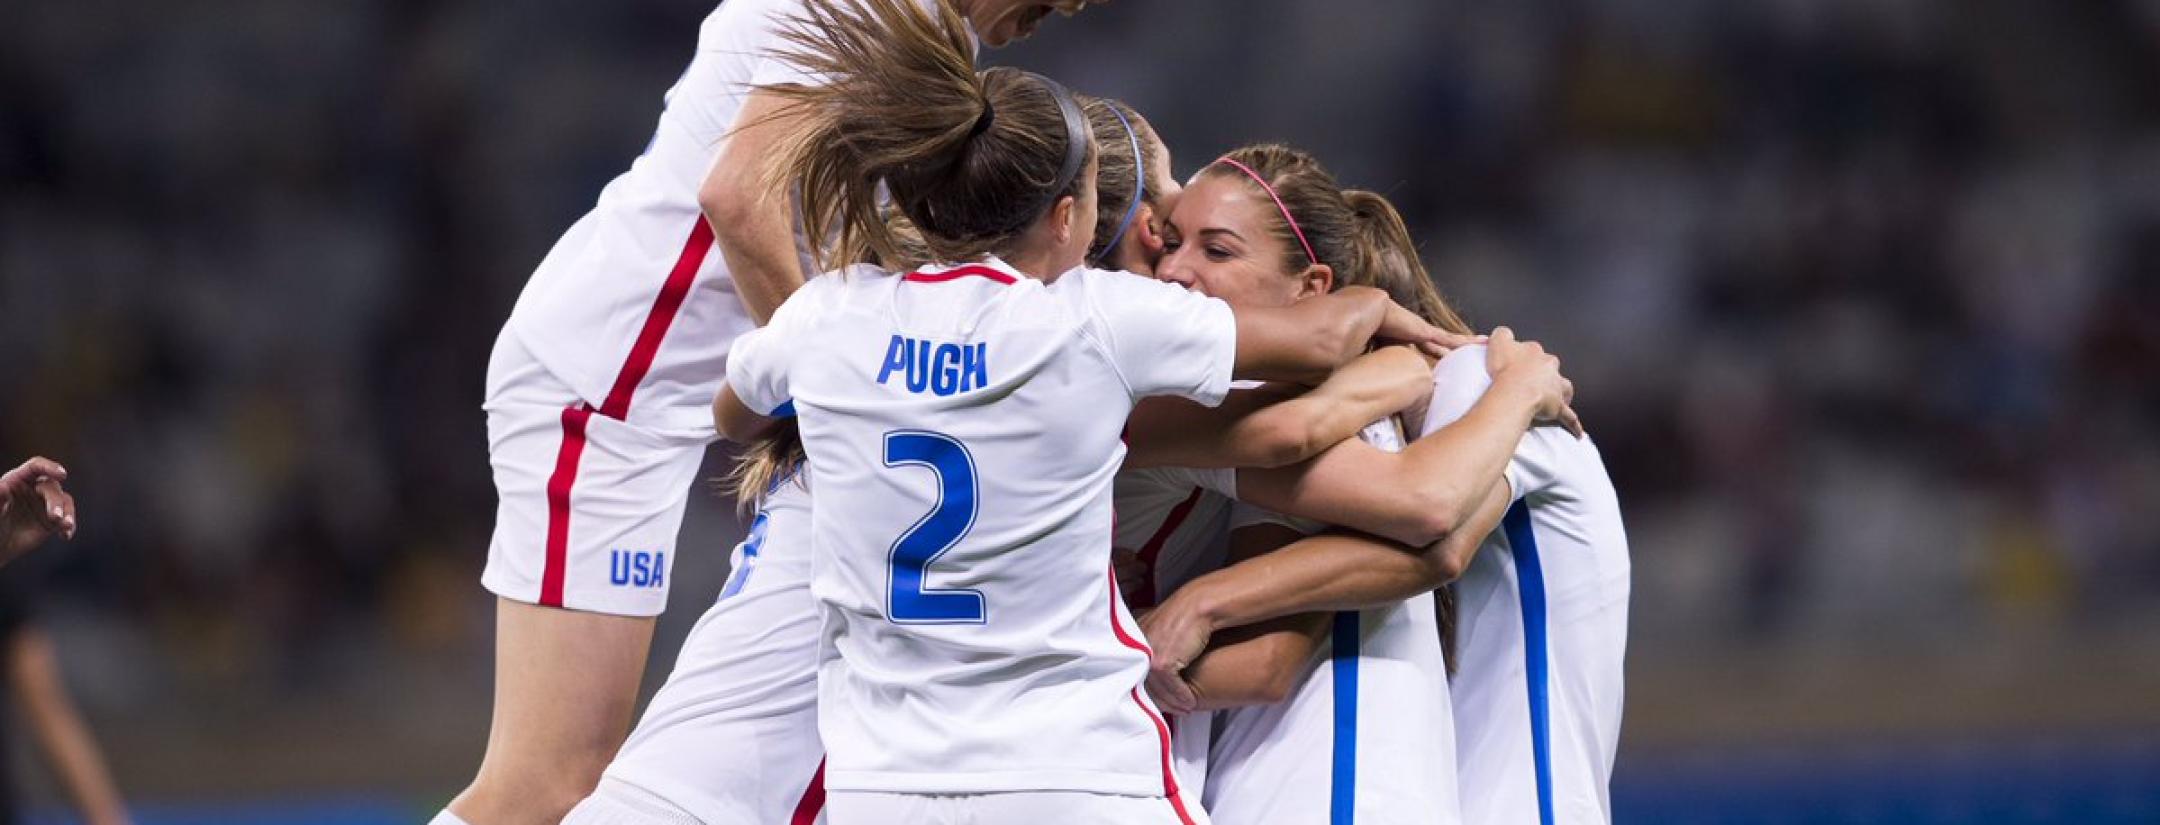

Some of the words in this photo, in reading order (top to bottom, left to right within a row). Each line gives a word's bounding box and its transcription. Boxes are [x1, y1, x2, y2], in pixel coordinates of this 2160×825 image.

[876, 334, 988, 396] PUGH
[883, 429, 986, 625] 2
[611, 550, 664, 587] USA
